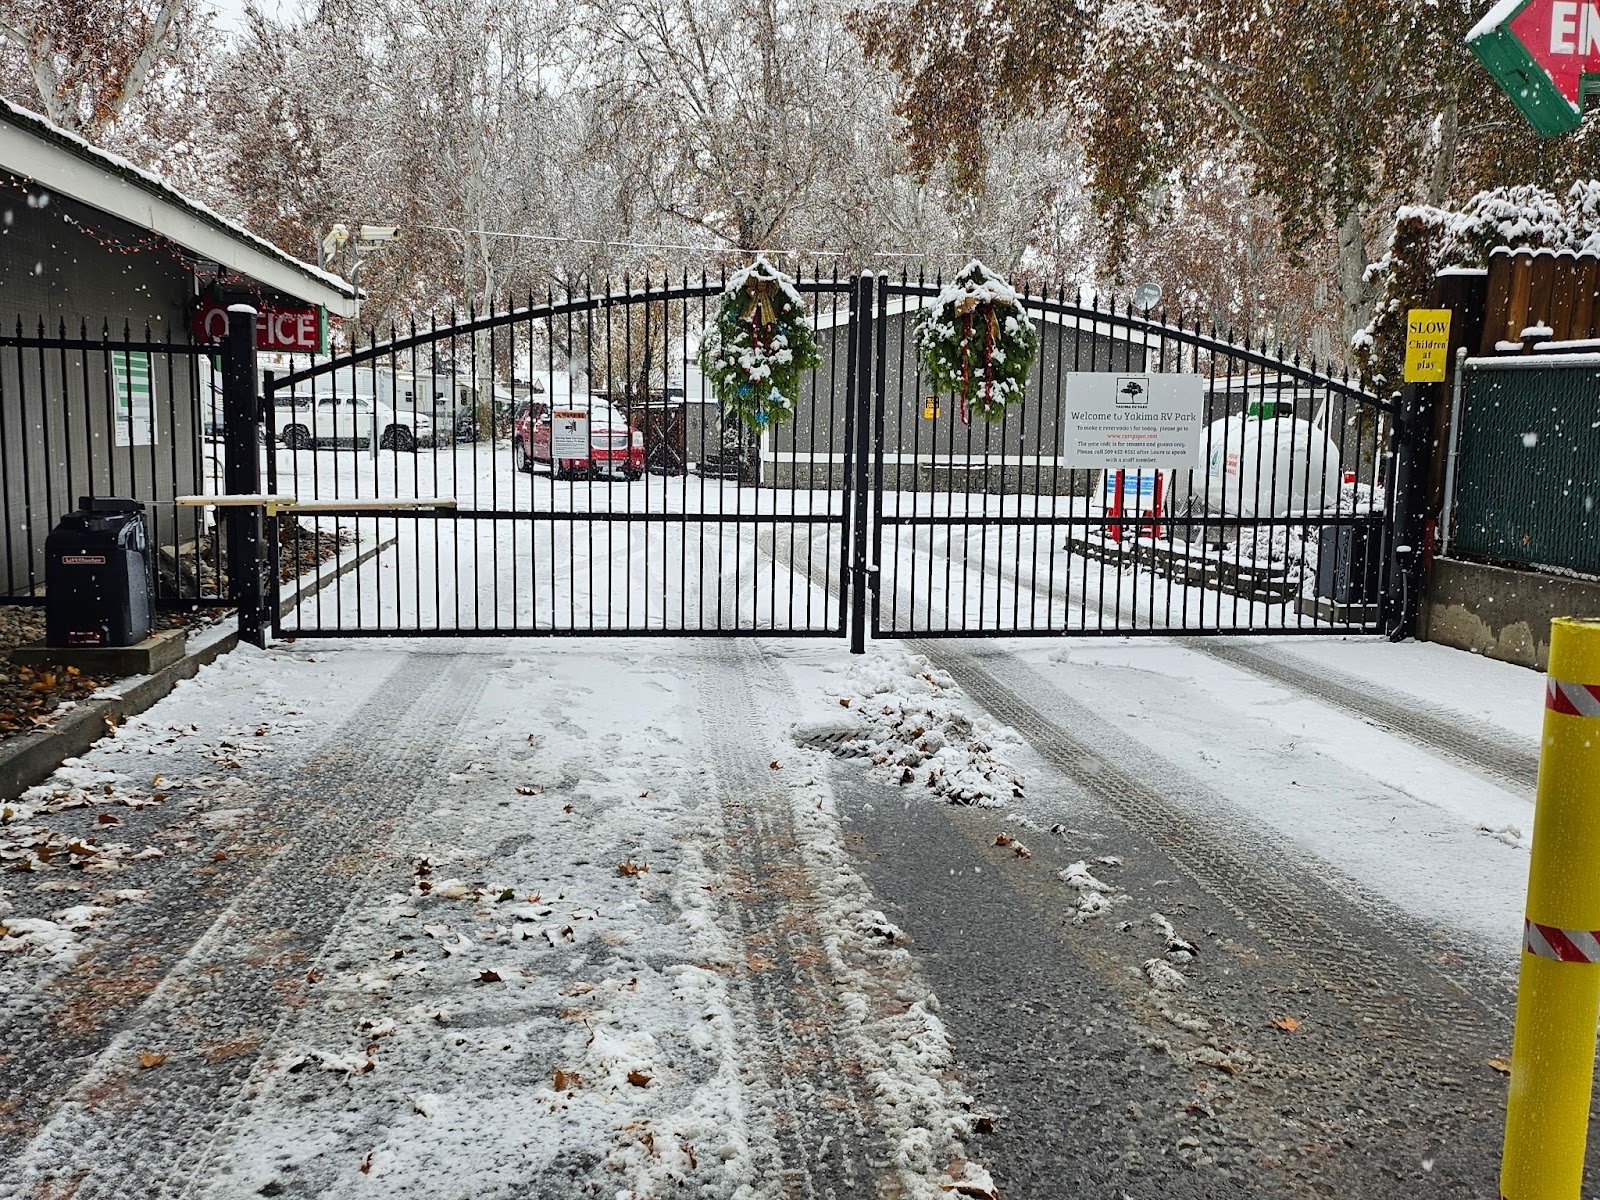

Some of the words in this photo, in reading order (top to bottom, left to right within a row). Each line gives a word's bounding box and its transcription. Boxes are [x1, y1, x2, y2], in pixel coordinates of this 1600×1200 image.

[204, 308, 315, 346] OFICE
[1409, 321, 1448, 334] SLOW
[1409, 340, 1446, 349] Children
[1422, 351, 1431, 359] at
[1417, 360, 1434, 370] play
[1071, 411, 1112, 420] Welcome
[1124, 411, 1159, 420] Yakima
[1160, 412, 1173, 420] RV
[1174, 412, 1196, 421] Park
